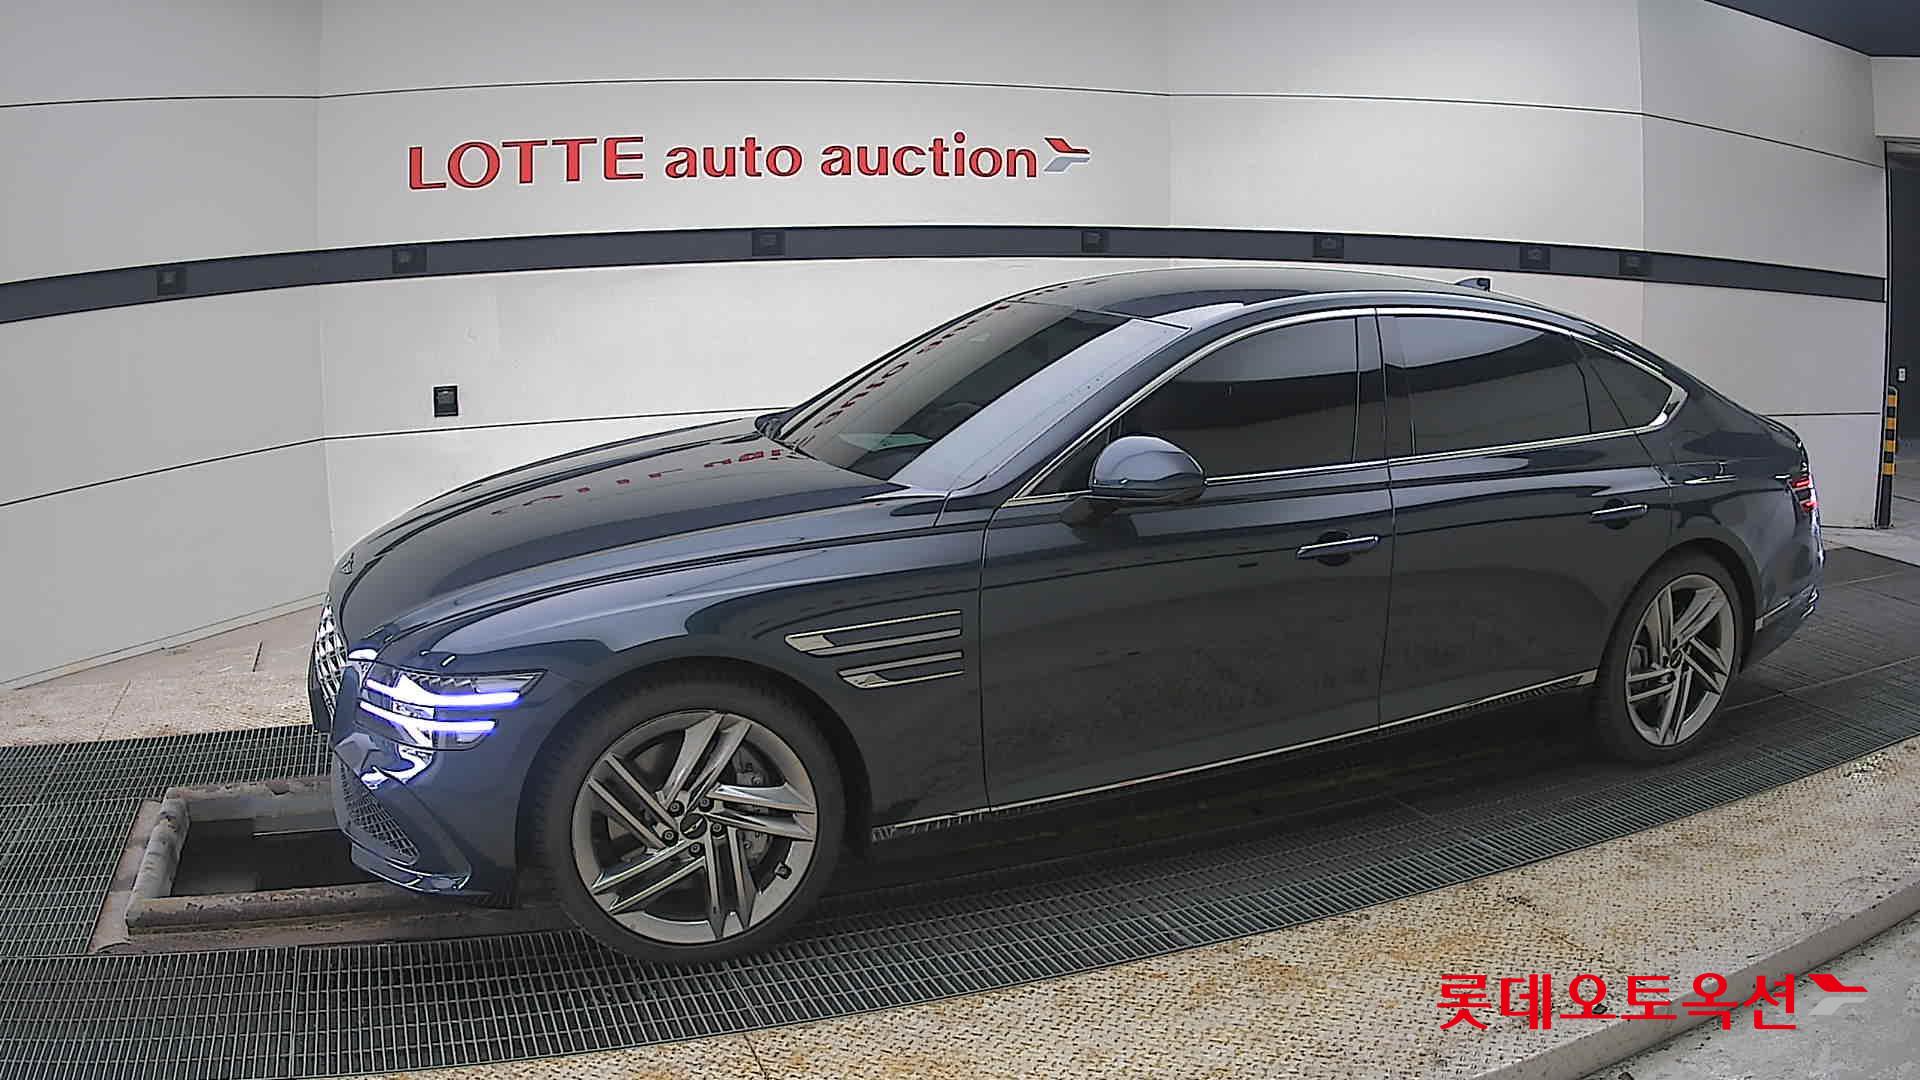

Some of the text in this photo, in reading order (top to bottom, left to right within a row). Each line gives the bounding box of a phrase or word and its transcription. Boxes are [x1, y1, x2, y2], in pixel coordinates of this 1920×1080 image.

[408, 132, 1038, 190] LOTTE auto auction
